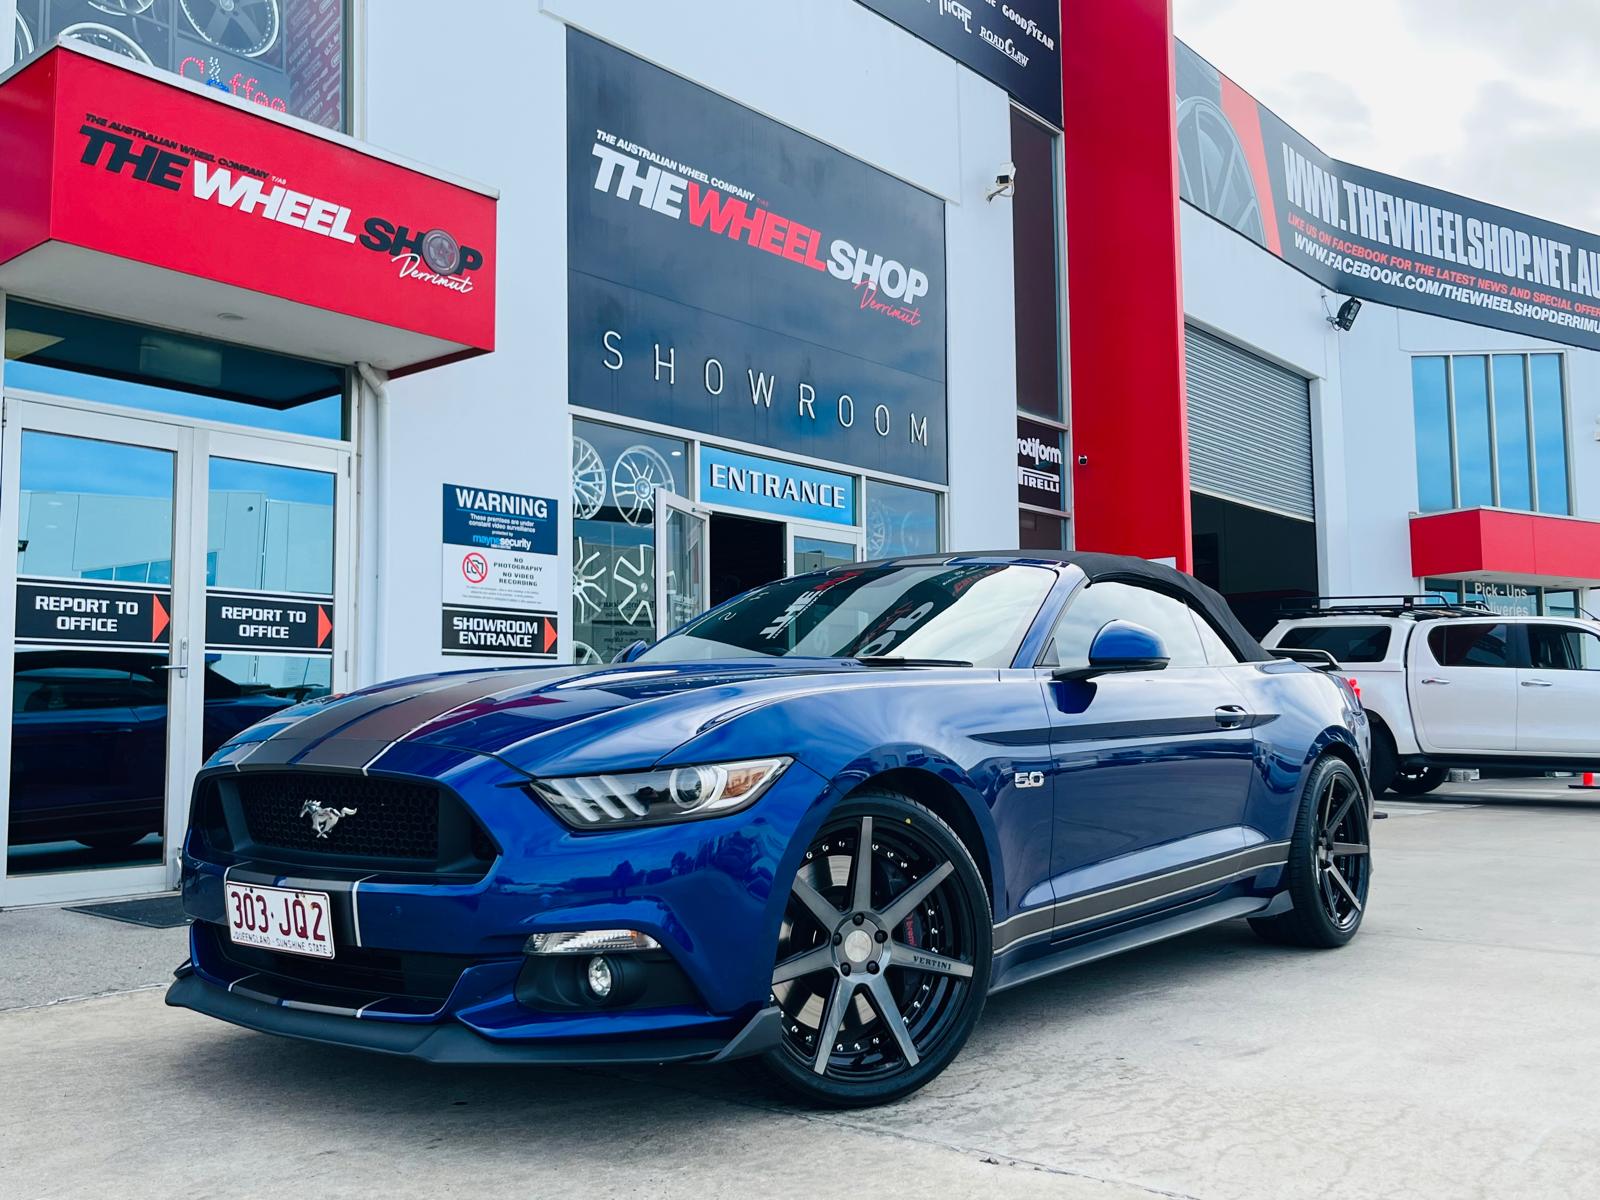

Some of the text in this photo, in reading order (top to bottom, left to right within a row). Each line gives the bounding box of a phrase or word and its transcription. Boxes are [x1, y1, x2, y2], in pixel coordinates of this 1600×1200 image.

[1002, 4, 1055, 51] GOODYEAR
[85, 113, 108, 127] THE
[108, 119, 178, 150] AUSTRALIAN
[180, 143, 216, 163] WHEEL
[217, 157, 270, 179] COMPANY
[596, 129, 755, 201] THE AUSTRALIAN WHEEL COMPANY
[80, 124, 190, 192] THE
[193, 160, 357, 244] WHEEL
[591, 143, 929, 305] THE WHEEL SHOP
[1288, 211, 1305, 231] LIKE
[1305, 223, 1317, 239] US
[1318, 231, 1331, 246] ON
[1331, 237, 1389, 266] FACEBOOK
[1389, 254, 1412, 272] FOR
[1414, 262, 1435, 277] THE
[1436, 268, 1477, 287] LATEST
[1477, 277, 1508, 295] NEWS
[1509, 286, 1531, 300] AND
[1532, 291, 1572, 311] SPECIAL
[391, 253, 474, 294] Derrimut
[854, 280, 921, 327] Derrimut
[602, 330, 929, 448] SHOWROOM
[710, 463, 846, 510] ENTRANCE
[1018, 466, 1060, 493] PIRELLI
[455, 488, 547, 518] WARNING
[469, 520, 536, 534] constant video surveillance
[511, 518, 519, 526] are
[520, 519, 534, 527] under
[494, 562, 543, 572] PHOTOGRAPHY
[514, 572, 534, 580] VIDEO
[498, 578, 538, 587] RECORDING
[1474, 582, 1498, 597] Pick
[1506, 584, 1528, 600] Ups
[35, 595, 139, 615] REPORT TO
[221, 606, 307, 624] REPORT TO
[56, 616, 118, 632] OFFICE
[238, 624, 290, 639] OFFICE
[453, 616, 538, 635] SHOWROOM
[459, 631, 532, 648] ENTRANCE
[233, 931, 328, 954] QUEENSLAND SUNSHINE STATE
[913, 955, 952, 970] VERTINI
